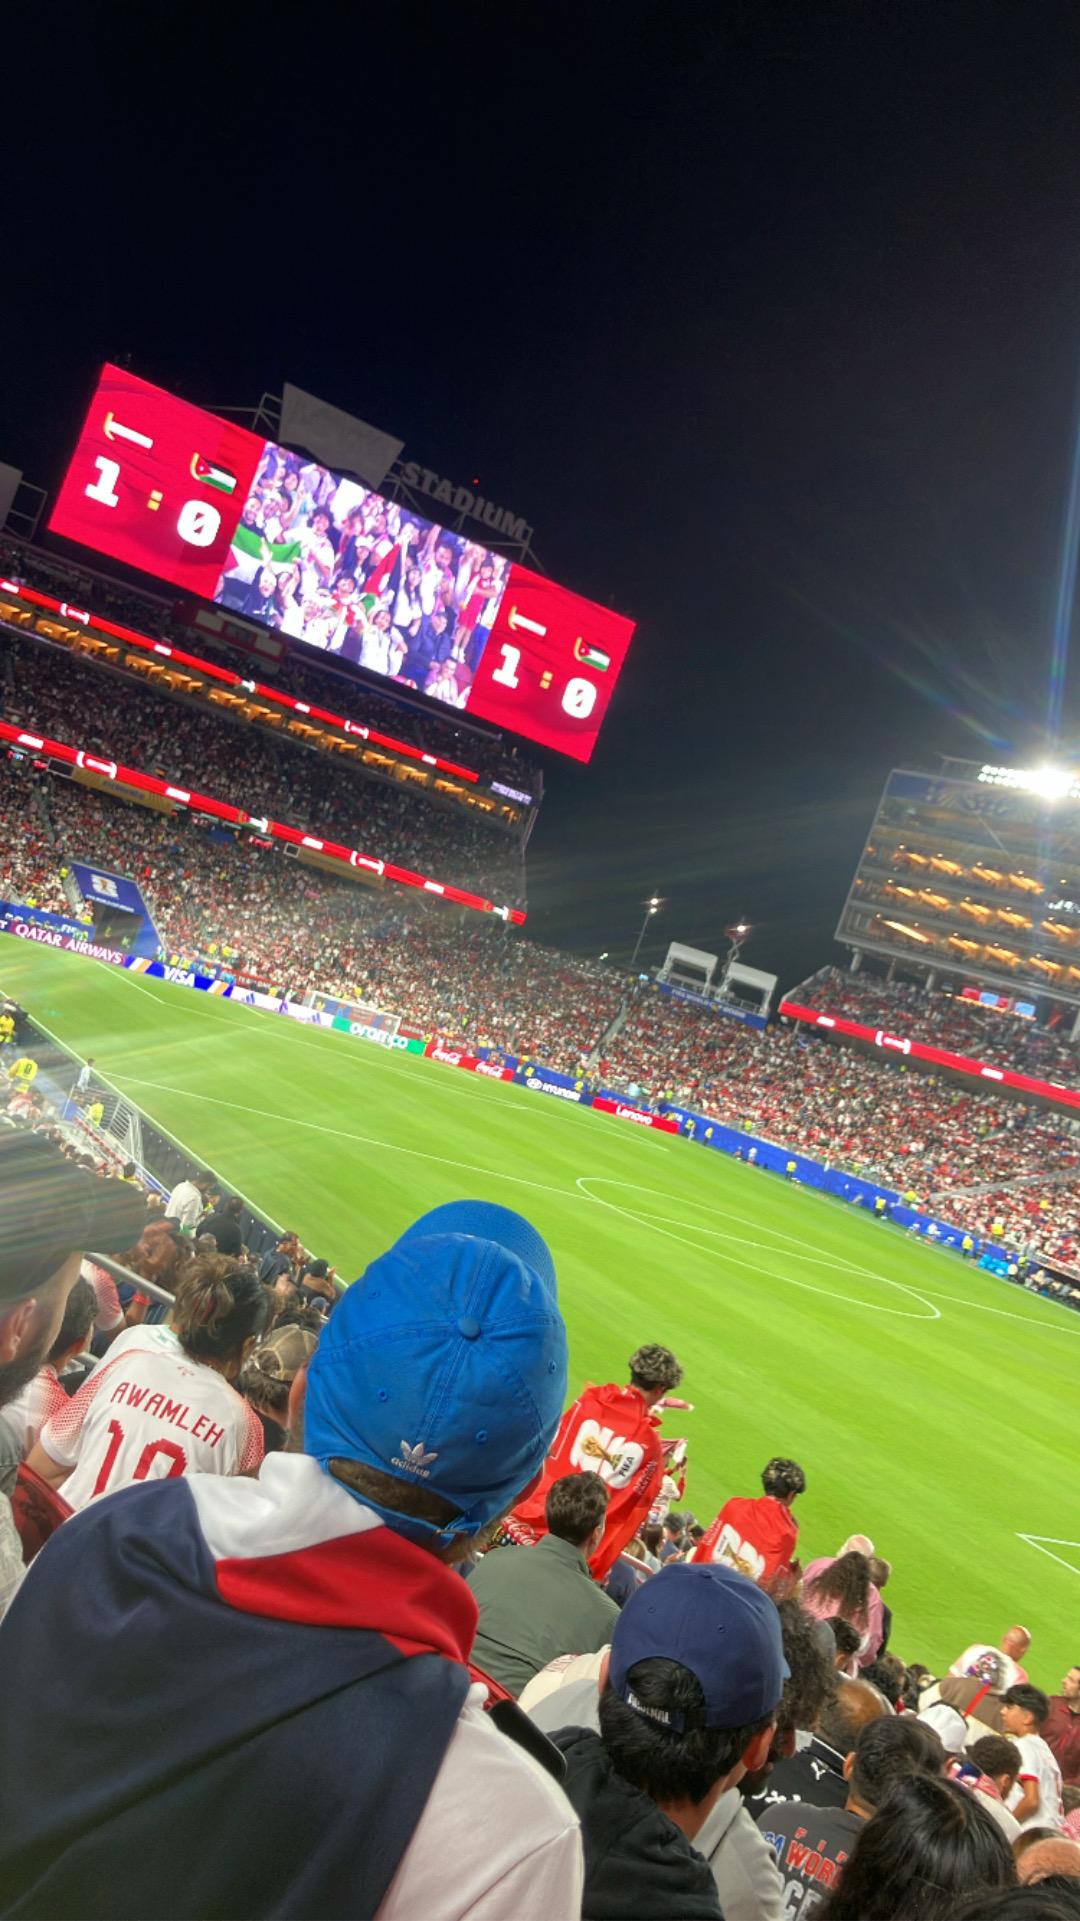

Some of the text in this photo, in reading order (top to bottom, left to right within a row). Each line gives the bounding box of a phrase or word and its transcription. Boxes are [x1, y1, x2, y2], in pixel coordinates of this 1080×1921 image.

[85, 456, 121, 508] 1
[177, 500, 222, 548] 0
[401, 461, 528, 541] STADIUM
[492, 644, 522, 690] 1
[561, 677, 598, 720] 0
[15, 923, 62, 947] QATAR
[66, 937, 123, 965] AIRWAYS
[163, 965, 196, 987] VISA
[349, 1022, 409, 1051] aramco
[616, 1104, 653, 1126] Lenovo
[110, 1381, 225, 1448] AWAMLEH
[391, 1456, 430, 1478] adidas
[785, 1840, 845, 1890] WORL
